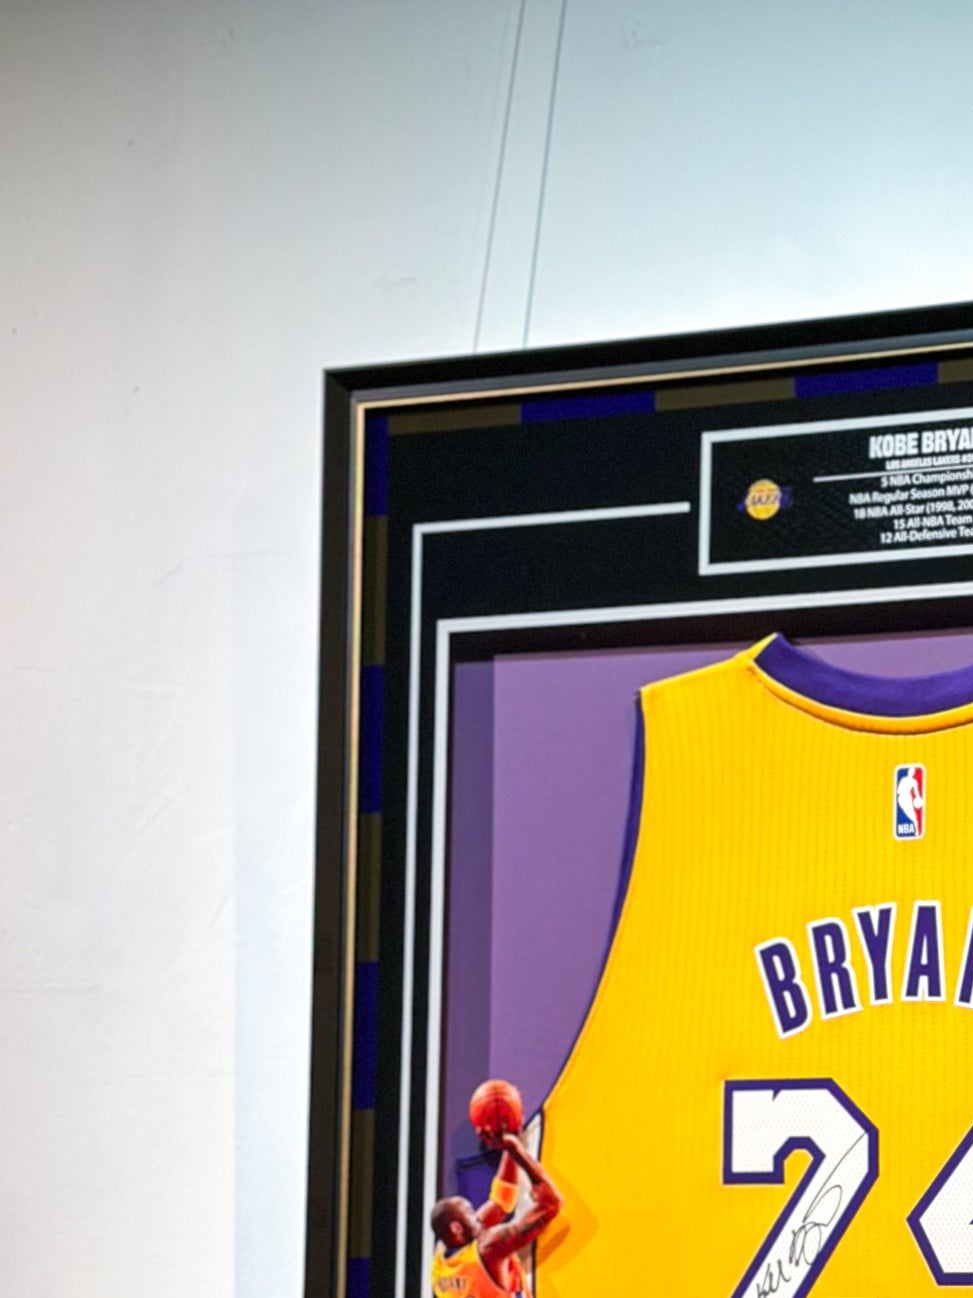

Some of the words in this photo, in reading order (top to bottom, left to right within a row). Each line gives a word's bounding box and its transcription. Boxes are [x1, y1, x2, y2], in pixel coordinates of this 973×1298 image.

[868, 432, 919, 459] KOBE
[880, 477, 888, 488] 5
[890, 474, 911, 487] NBA
[849, 492, 871, 505] NBA
[872, 489, 909, 505] Regular
[910, 487, 945, 500] Season
[946, 484, 970, 497] MVP
[853, 508, 867, 520] 18
[867, 505, 889, 518] NBA
[890, 502, 925, 516] All-Star
[926, 500, 956, 514] (1998,
[893, 519, 905, 530] 15
[907, 515, 944, 529] All-NBA
[945, 514, 973, 526] Team
[880, 532, 892, 544] 12
[893, 527, 957, 543] All-Defensive
[898, 823, 915, 834] NBA
